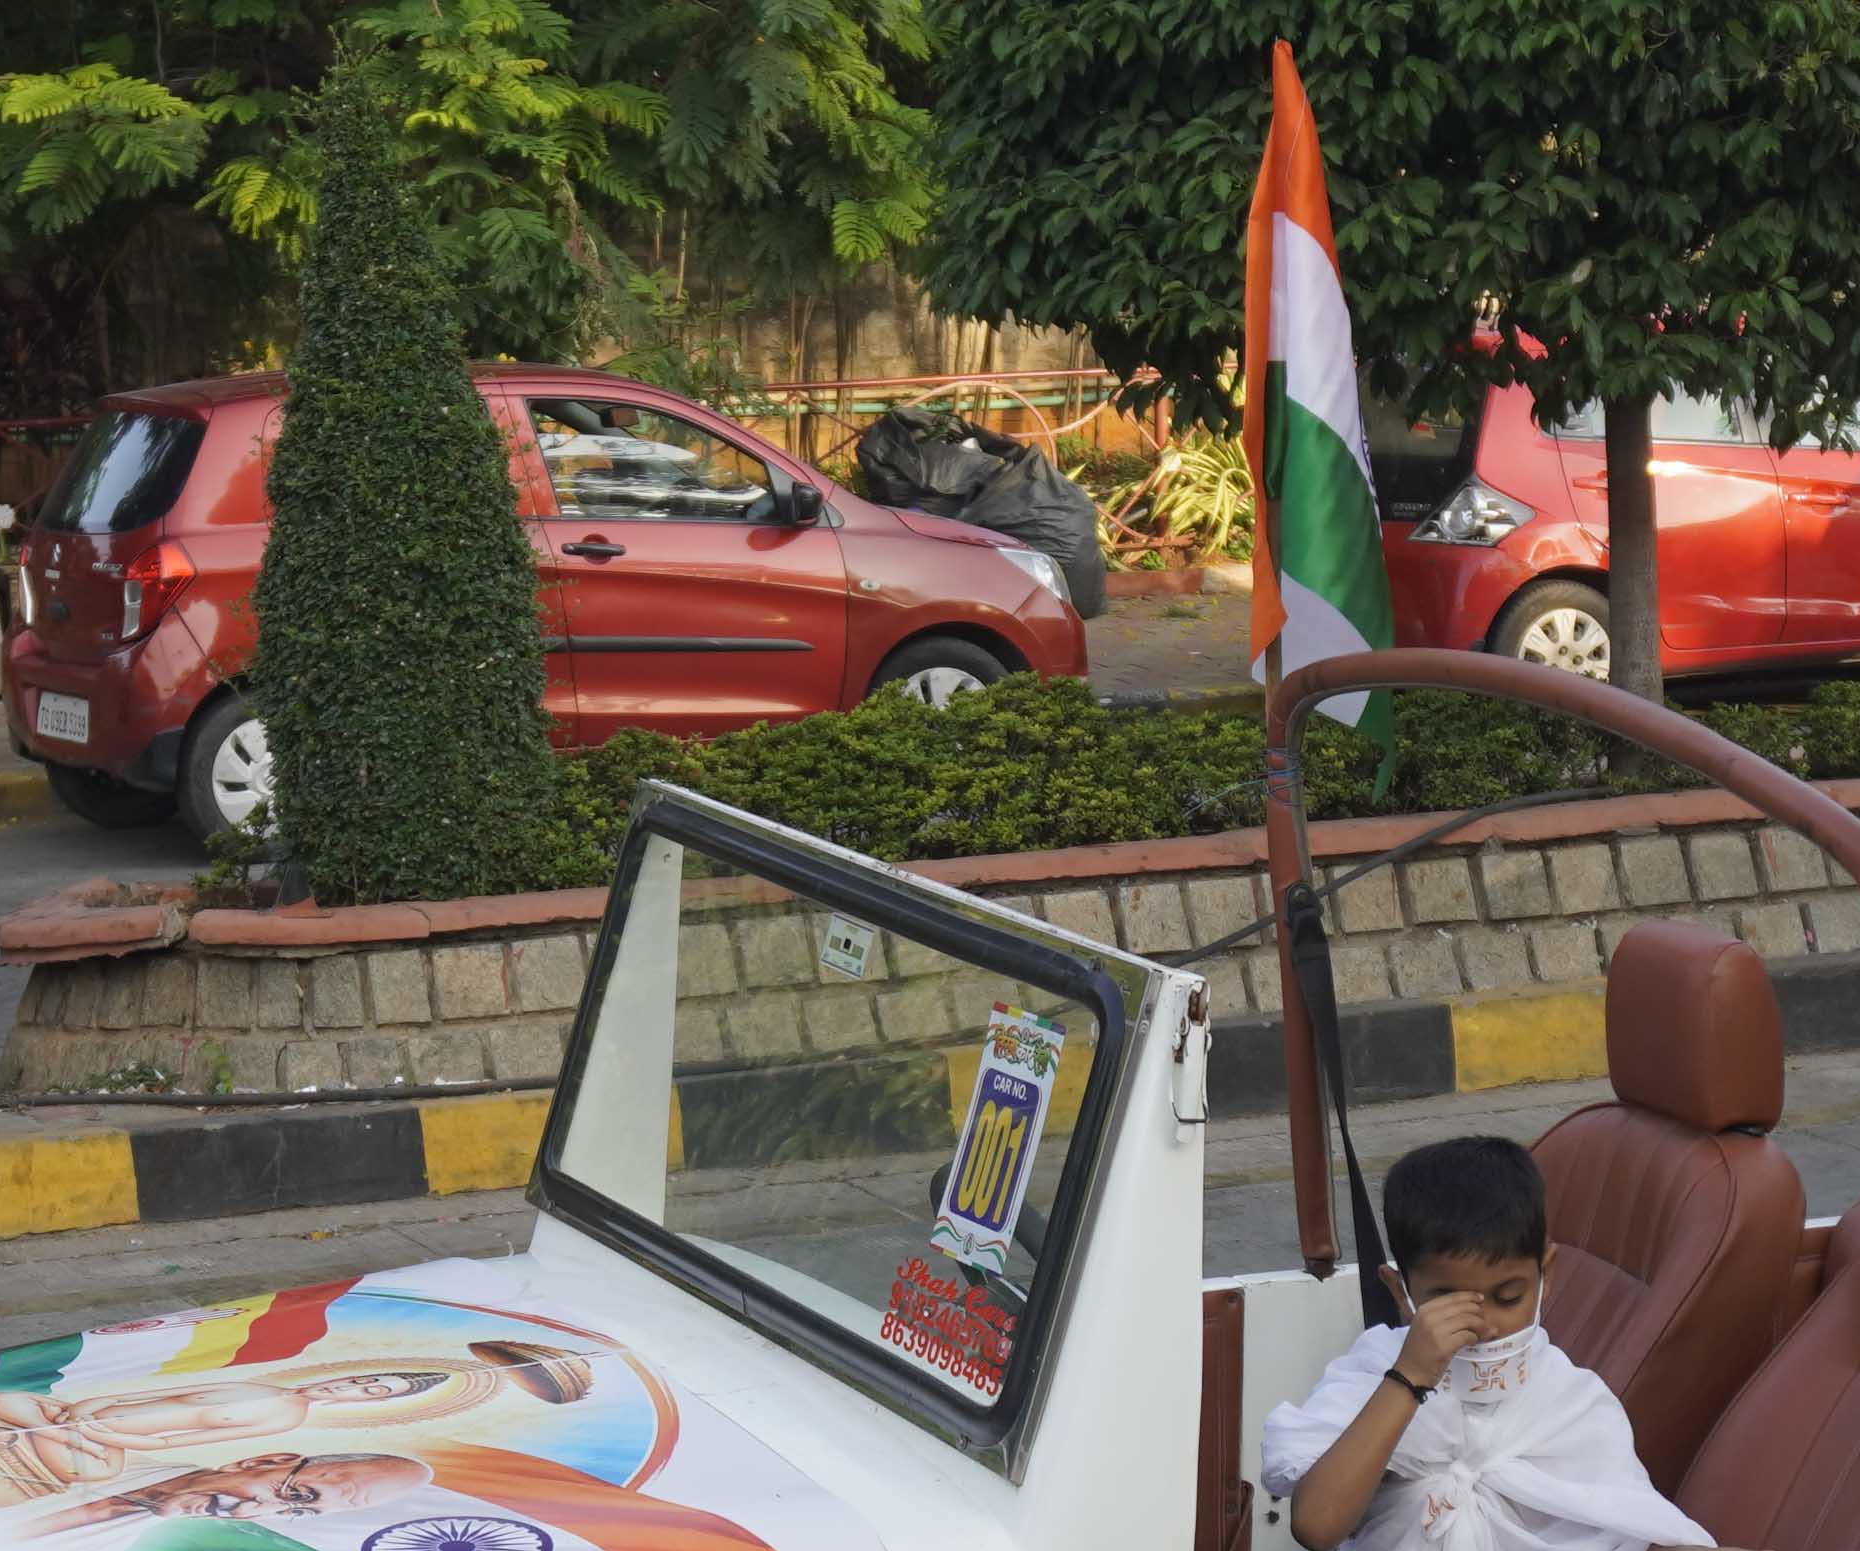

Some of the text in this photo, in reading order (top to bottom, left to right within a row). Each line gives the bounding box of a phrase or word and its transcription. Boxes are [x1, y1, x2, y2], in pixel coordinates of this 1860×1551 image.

[993, 1074, 1028, 1101] CAR NO.
[955, 1098, 1028, 1225] 001
[880, 1311, 1004, 1396] 8639098485
